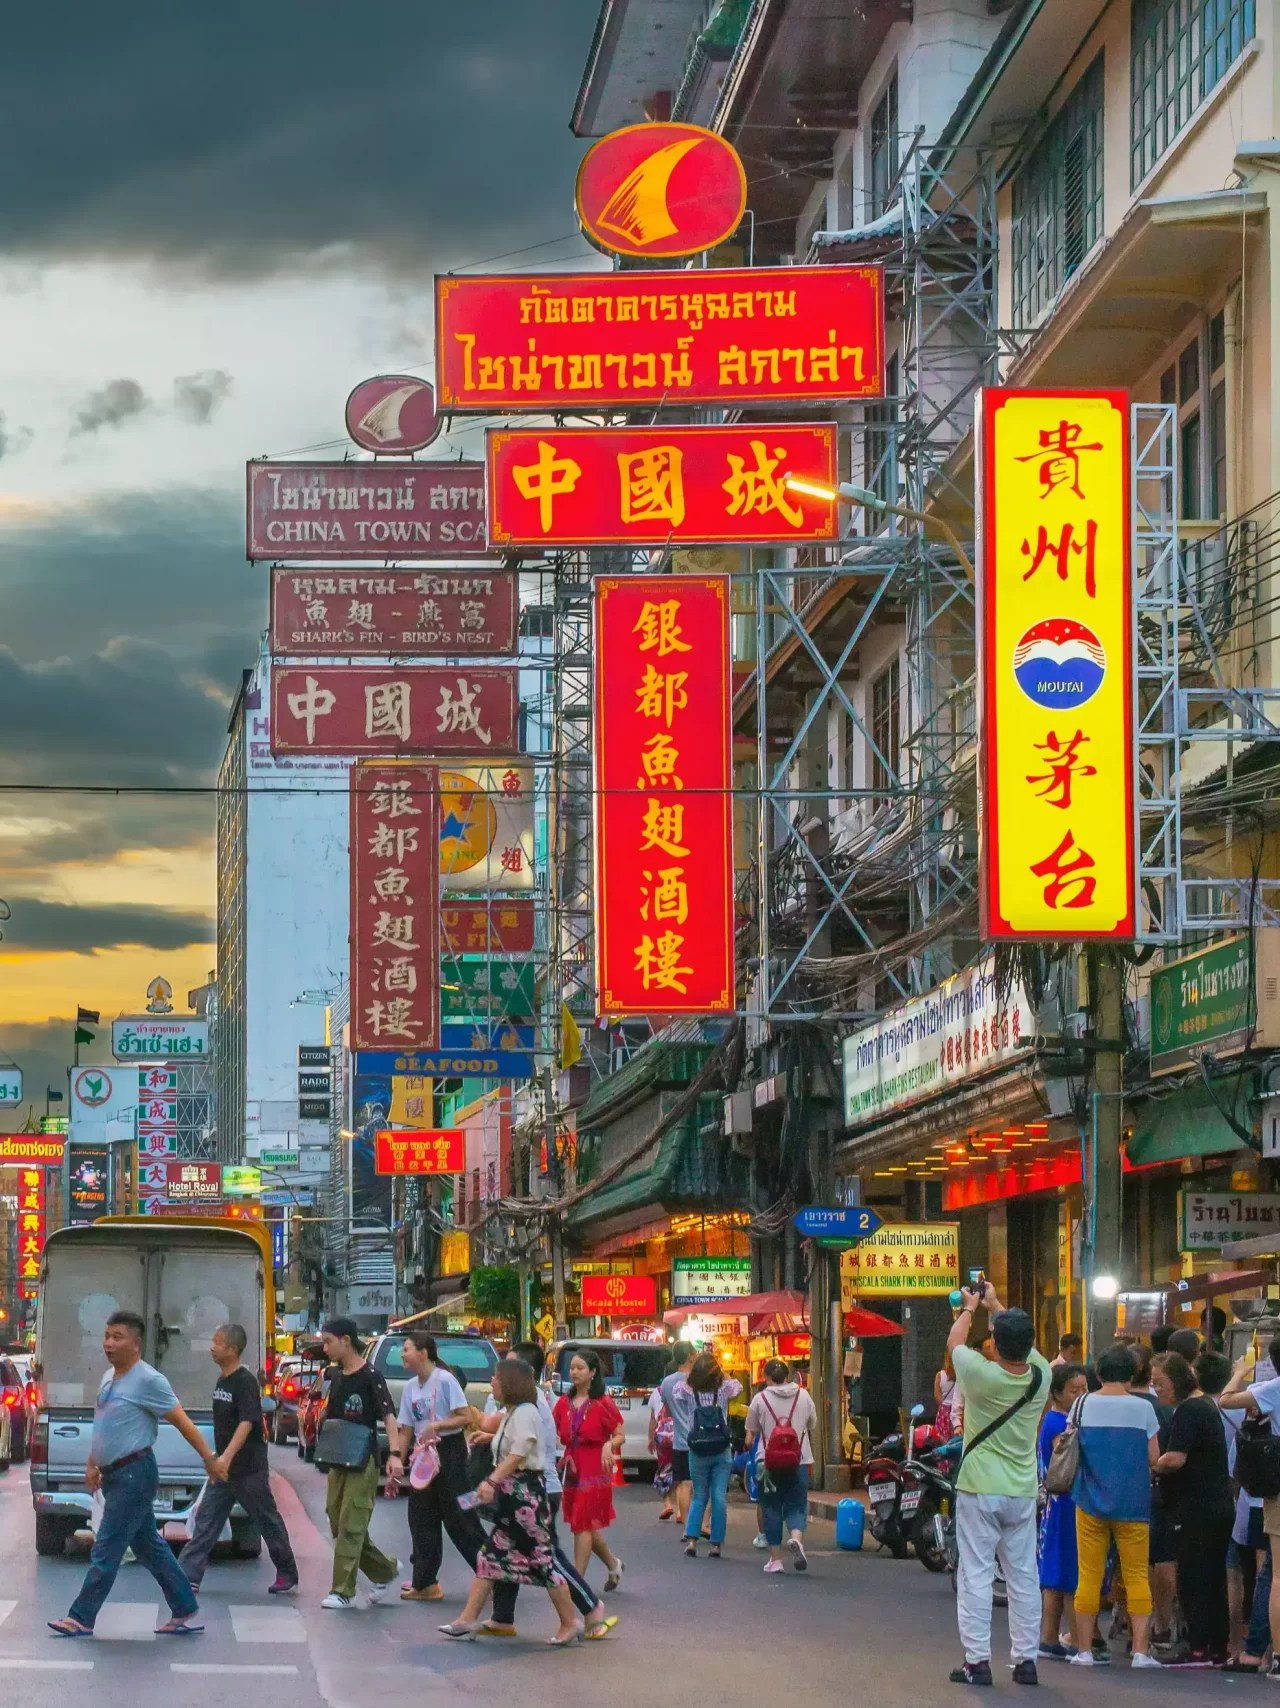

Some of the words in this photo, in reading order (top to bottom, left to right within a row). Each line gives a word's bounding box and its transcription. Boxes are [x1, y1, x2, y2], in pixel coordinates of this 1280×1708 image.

[454, 333, 694, 391] ไชน่าทาวน์
[718, 328, 865, 386] สกาล่า
[267, 473, 416, 511] ไชน่าทาวน์
[429, 485, 484, 510] สกา
[511, 440, 803, 533] 中國城
[266, 521, 346, 543] CHINA
[354, 521, 431, 543] TOWN
[438, 521, 486, 543] SCA
[291, 630, 354, 643] SHARK'S
[360, 631, 383, 643] FIN
[402, 631, 451, 643] BIRD'S
[456, 631, 494, 644] NEST
[1036, 681, 1084, 693] MOUTAI
[286, 675, 493, 746] 中國城
[631, 600, 694, 994] 銀都魚翅酒樓
[365, 781, 423, 1040] 銀都魚翅酒樓
[301, 1052, 328, 1060] CITIZEN
[393, 1057, 499, 1073] SEAFOOD
[301, 1077, 329, 1085] RADO
[907, 1057, 939, 1093] RESTAURANT
[168, 1181, 192, 1191] Hotel
[194, 1181, 218, 1193] Royal
[805, 1211, 846, 1221] เยาวราช
[859, 1213, 870, 1229] 2
[840, 1253, 957, 1268] 城銀都魚翅酒樓
[859, 1275, 879, 1288] SCALA
[918, 1275, 957, 1288] RESTAURANT
[586, 1299, 613, 1307] Scala
[616, 1299, 647, 1307] Hostel
